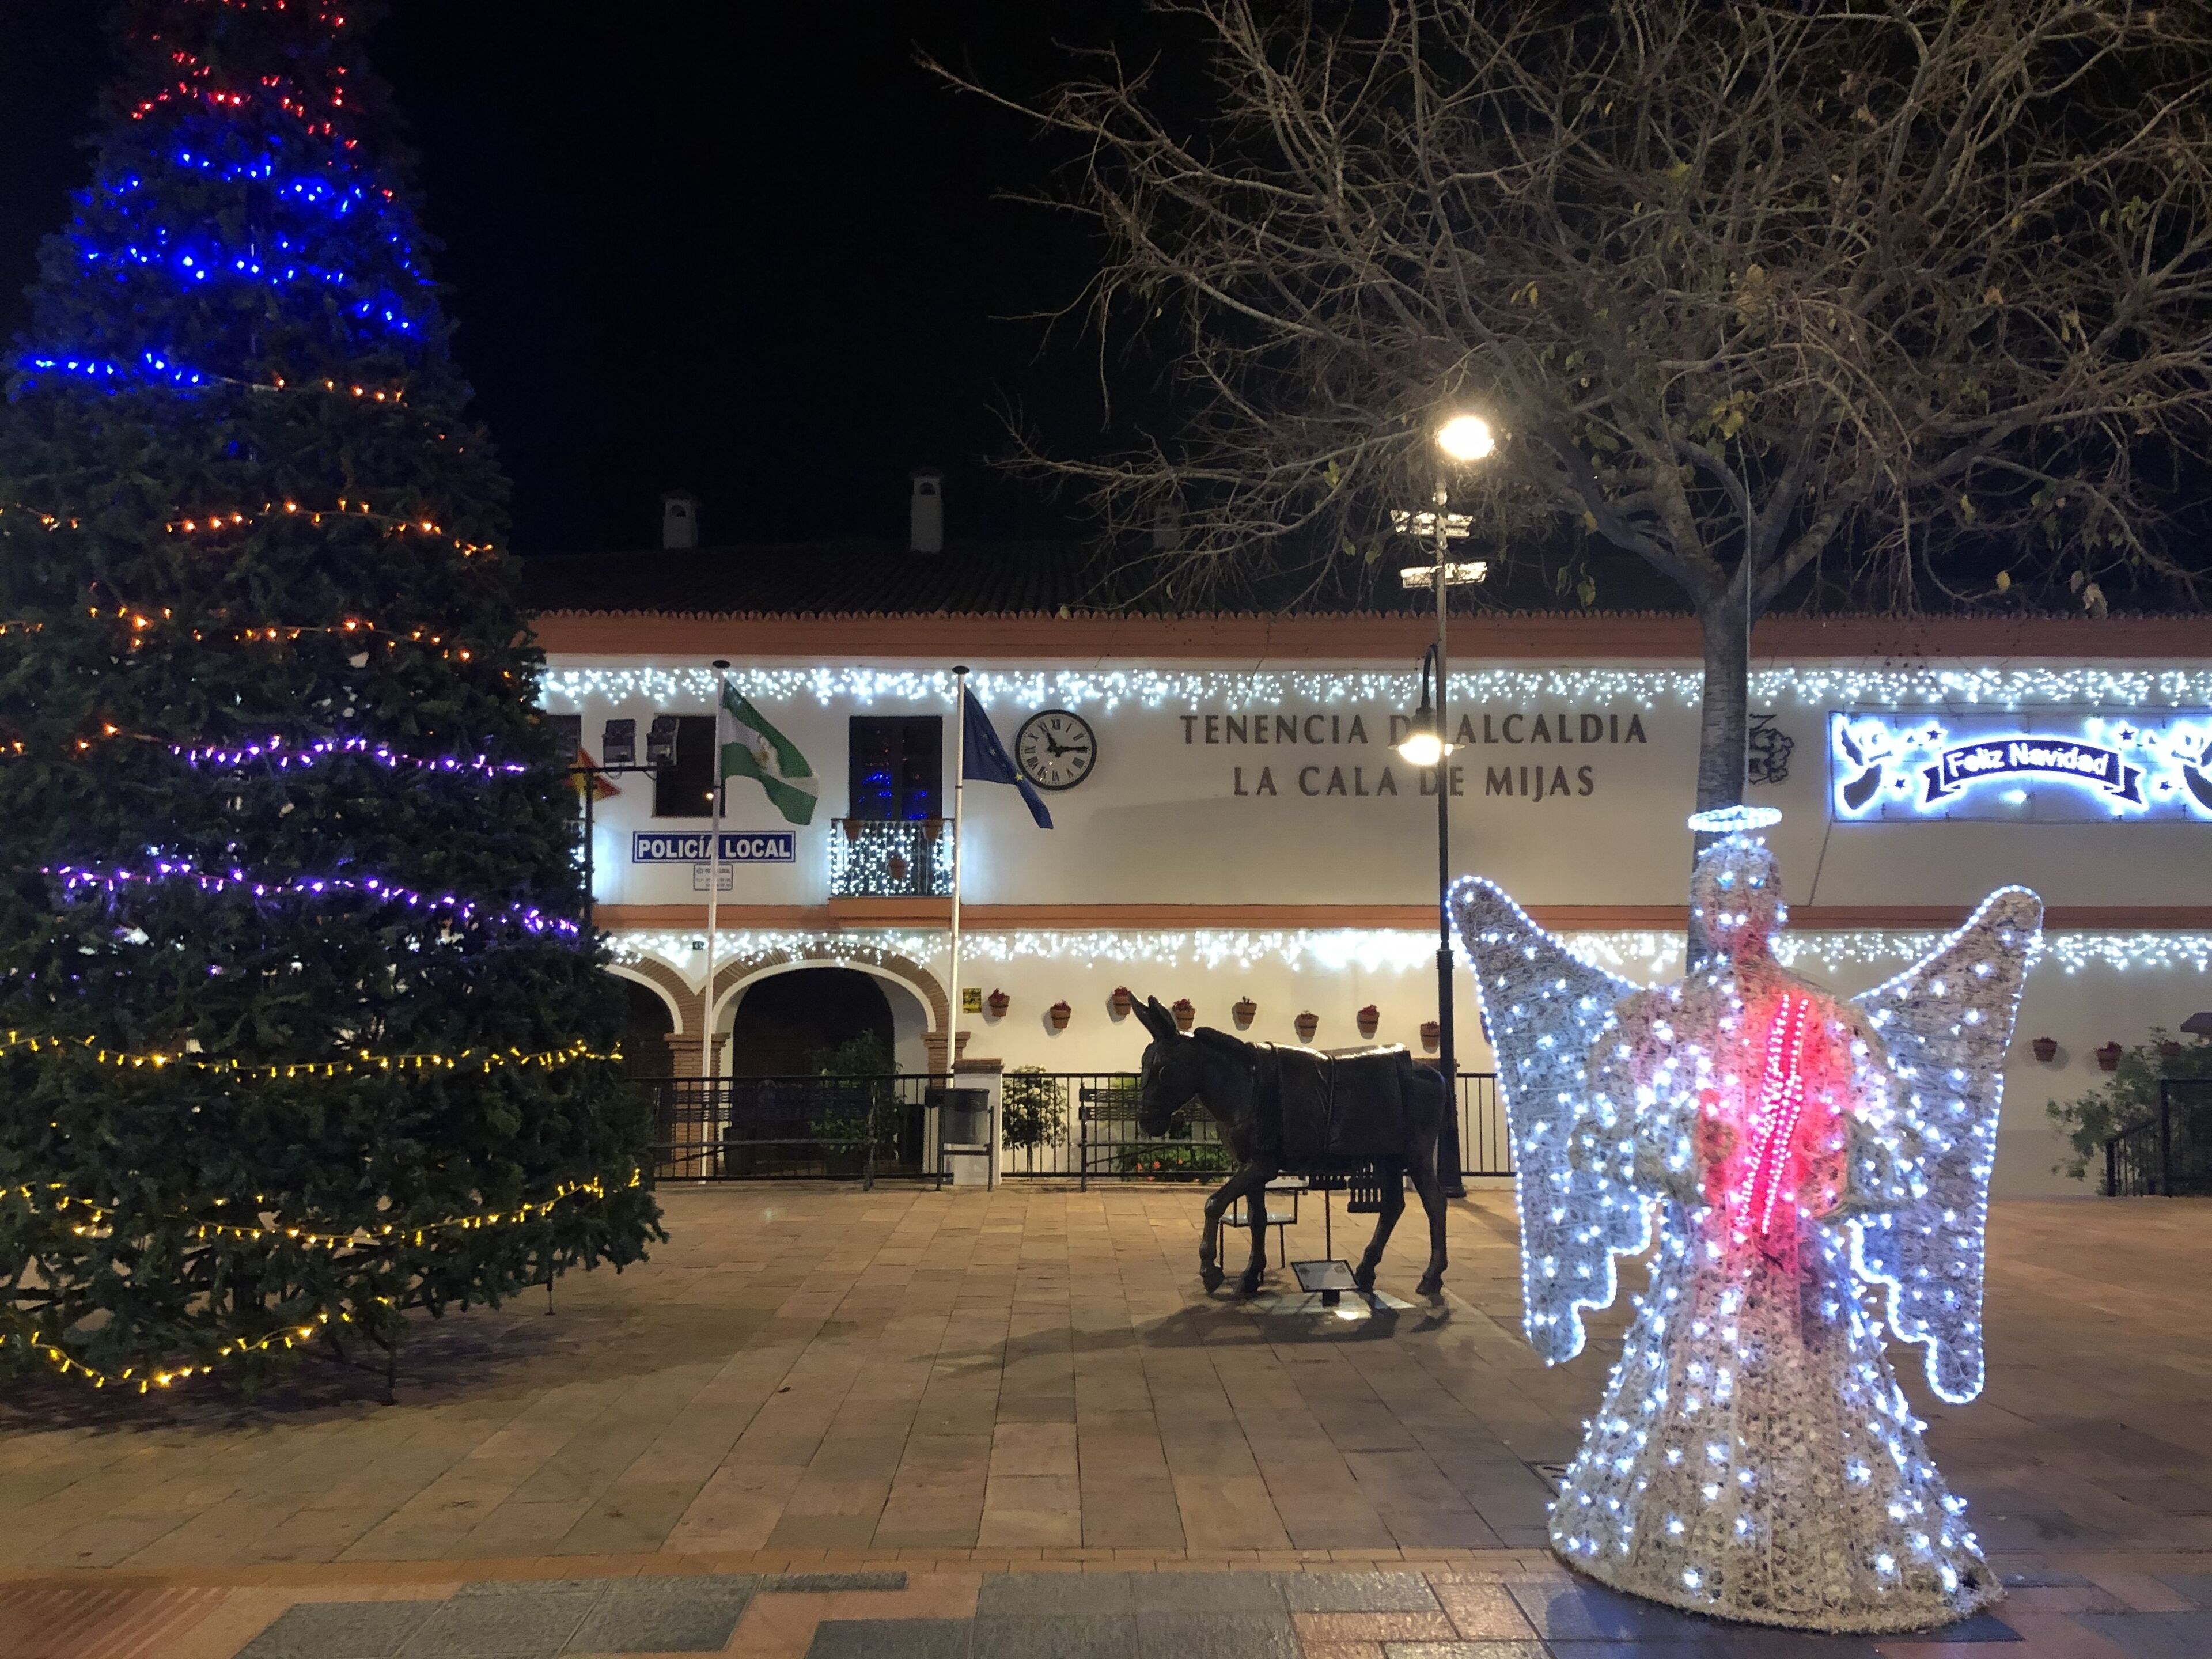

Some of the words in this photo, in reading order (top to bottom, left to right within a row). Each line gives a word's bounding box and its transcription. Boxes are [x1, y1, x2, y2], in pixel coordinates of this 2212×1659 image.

[1180, 715, 1368, 744] TENENCIA
[1456, 714, 1647, 743] ALCALDIA
[1946, 747, 2005, 777] Feliz
[2009, 743, 2109, 775] Navidad
[1234, 767, 1277, 796] LA
[1298, 767, 1398, 796] CALA
[1419, 767, 1464, 796] DE
[1485, 766, 1594, 802] MIJAS
[725, 839, 791, 858] LOCAL
